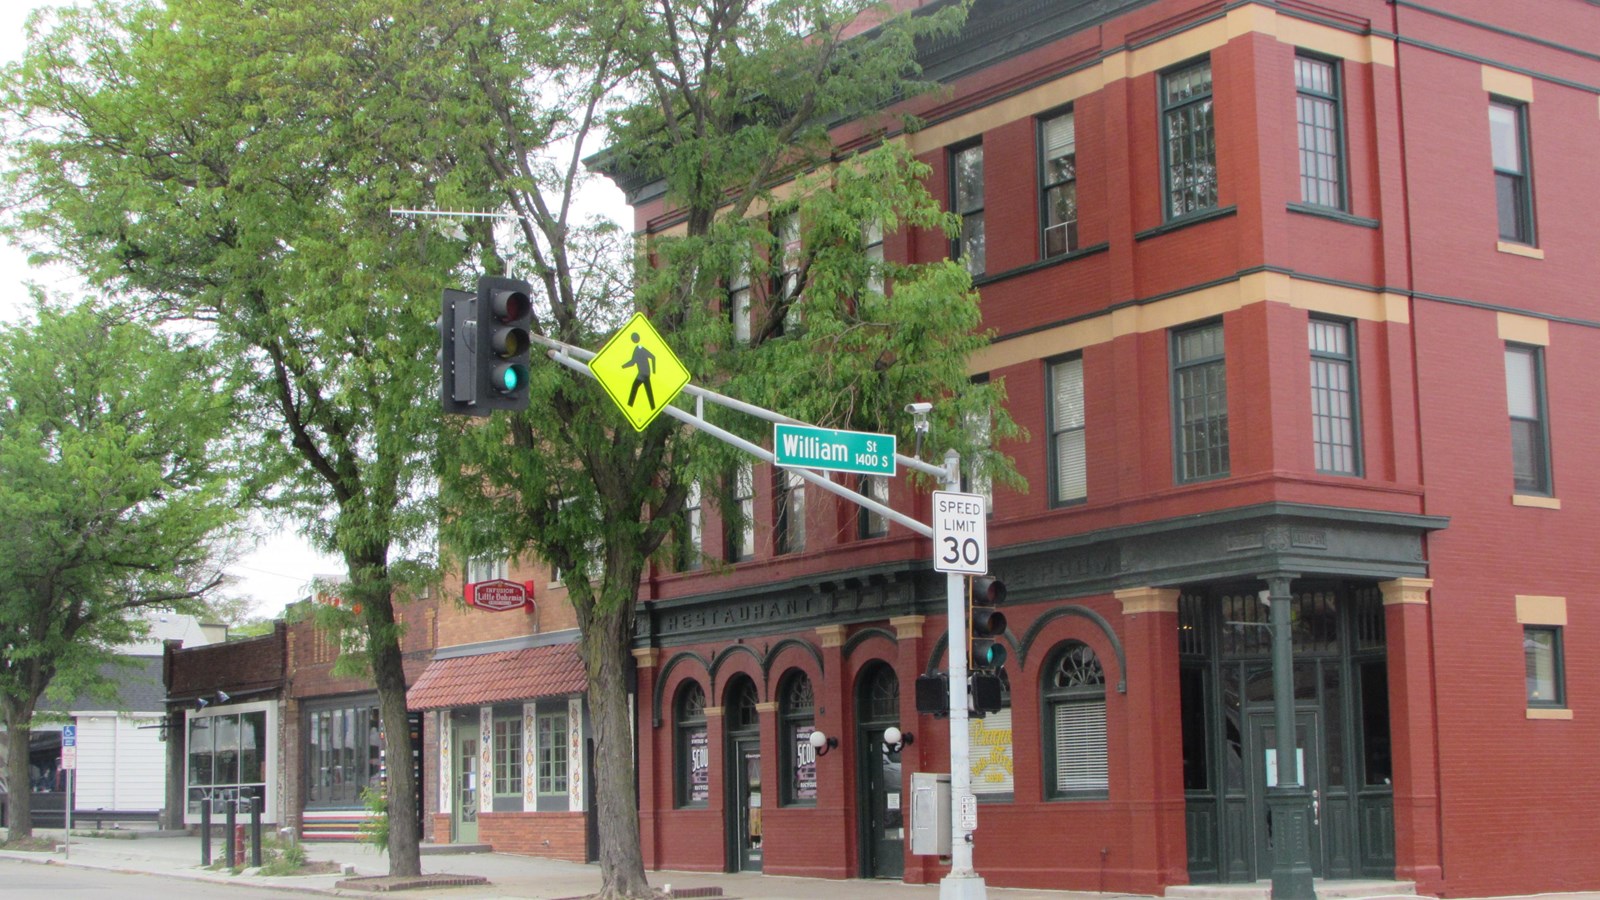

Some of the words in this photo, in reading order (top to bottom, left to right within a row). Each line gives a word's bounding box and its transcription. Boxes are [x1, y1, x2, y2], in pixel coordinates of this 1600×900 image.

[783, 433, 848, 462] William
[866, 441, 877, 453] St
[855, 454, 878, 467] 1400
[881, 455, 889, 468] S
[939, 500, 981, 515] SPEED
[944, 519, 976, 533] LIMIT
[942, 536, 980, 565] 30
[478, 592, 494, 600] Little
[496, 593, 522, 601] Bohemia
[669, 599, 812, 630] RESTAURANT
[692, 748, 708, 772] SCOU
[797, 743, 815, 768] SCOU
